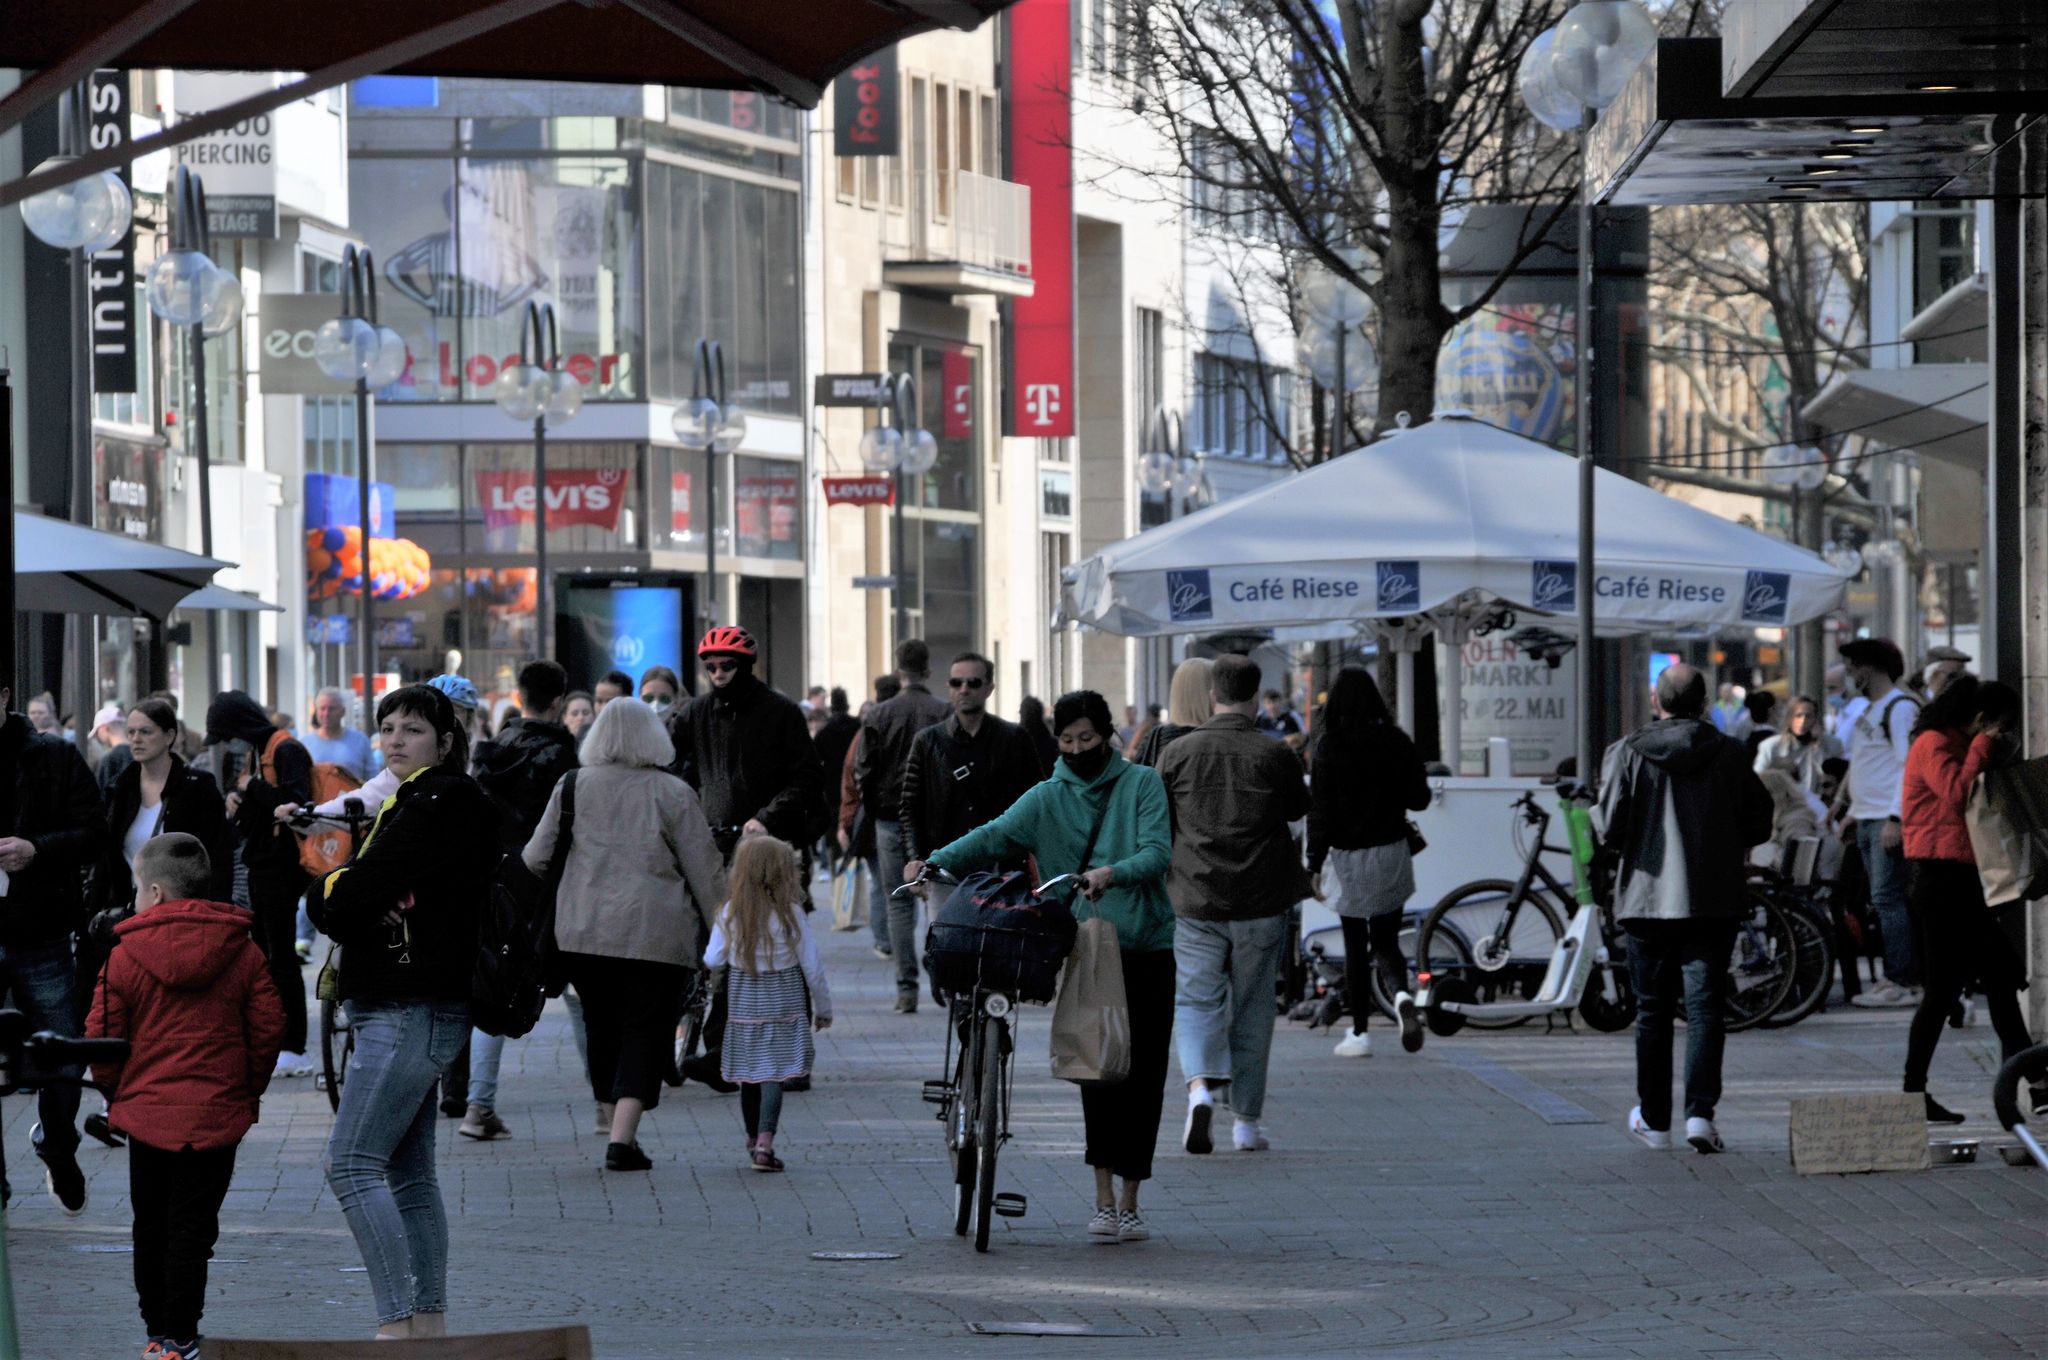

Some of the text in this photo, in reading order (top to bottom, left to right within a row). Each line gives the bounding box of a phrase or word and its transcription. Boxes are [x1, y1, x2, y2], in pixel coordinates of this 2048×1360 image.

[178, 143, 271, 164] PIERCING
[208, 213, 258, 233] ETAGE
[1230, 577, 1359, 602] Café Riese
[1595, 576, 1726, 602] Café Riese
